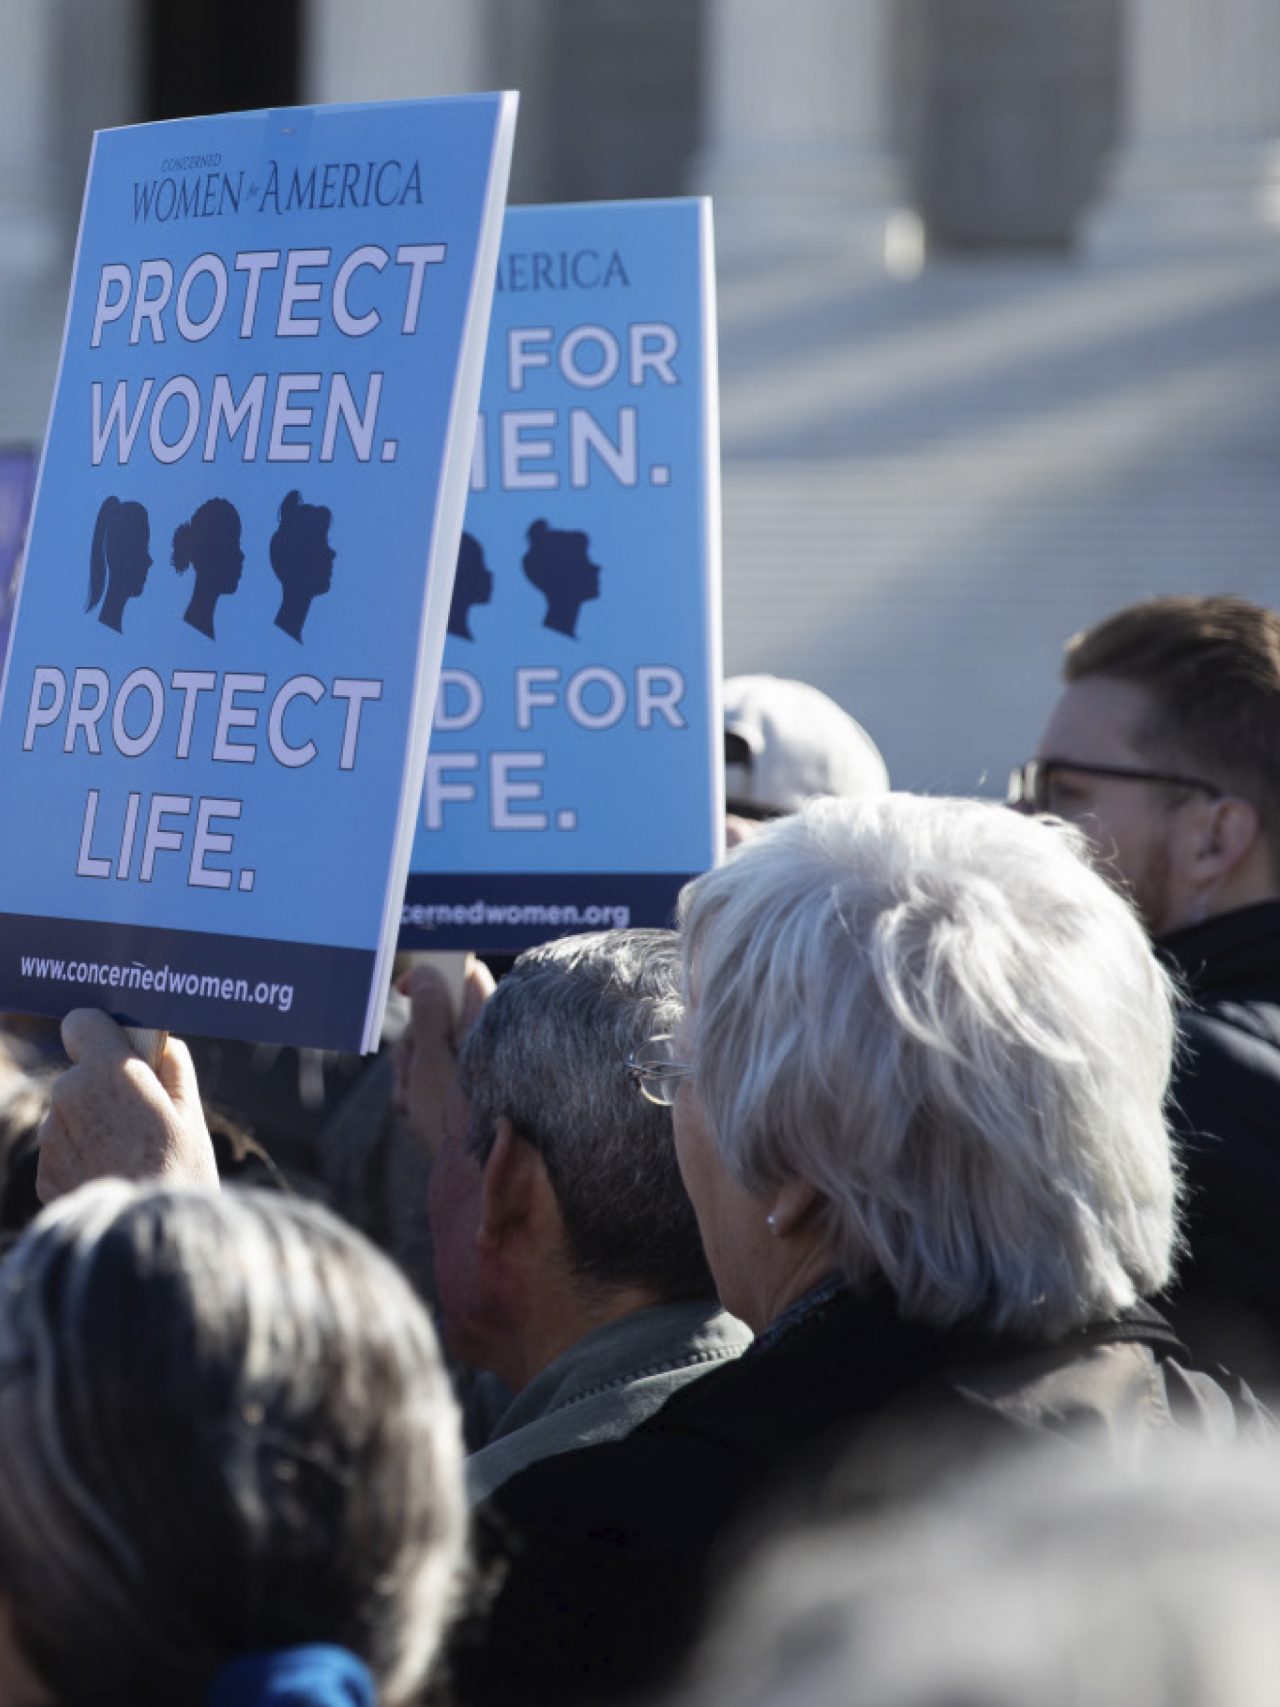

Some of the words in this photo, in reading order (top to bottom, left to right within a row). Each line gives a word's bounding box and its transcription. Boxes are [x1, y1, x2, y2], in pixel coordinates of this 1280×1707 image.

[132, 171, 245, 224] WOMEN
[258, 159, 424, 215] AMERICA
[160, 153, 222, 172] CONCERNED
[90, 242, 448, 348] PROTECT
[495, 249, 630, 292] ERICA
[507, 321, 680, 392] FOR
[90, 371, 399, 466] WOMEN.
[470, 405, 671, 492] EN.
[22, 666, 384, 770] PROTECT
[515, 665, 688, 730] FOR
[423, 751, 577, 832] FE.
[75, 789, 256, 892] LIFE.
[400, 900, 630, 928] cernedwomen.org
[20, 956, 294, 1012] www.concernedwomen.org
